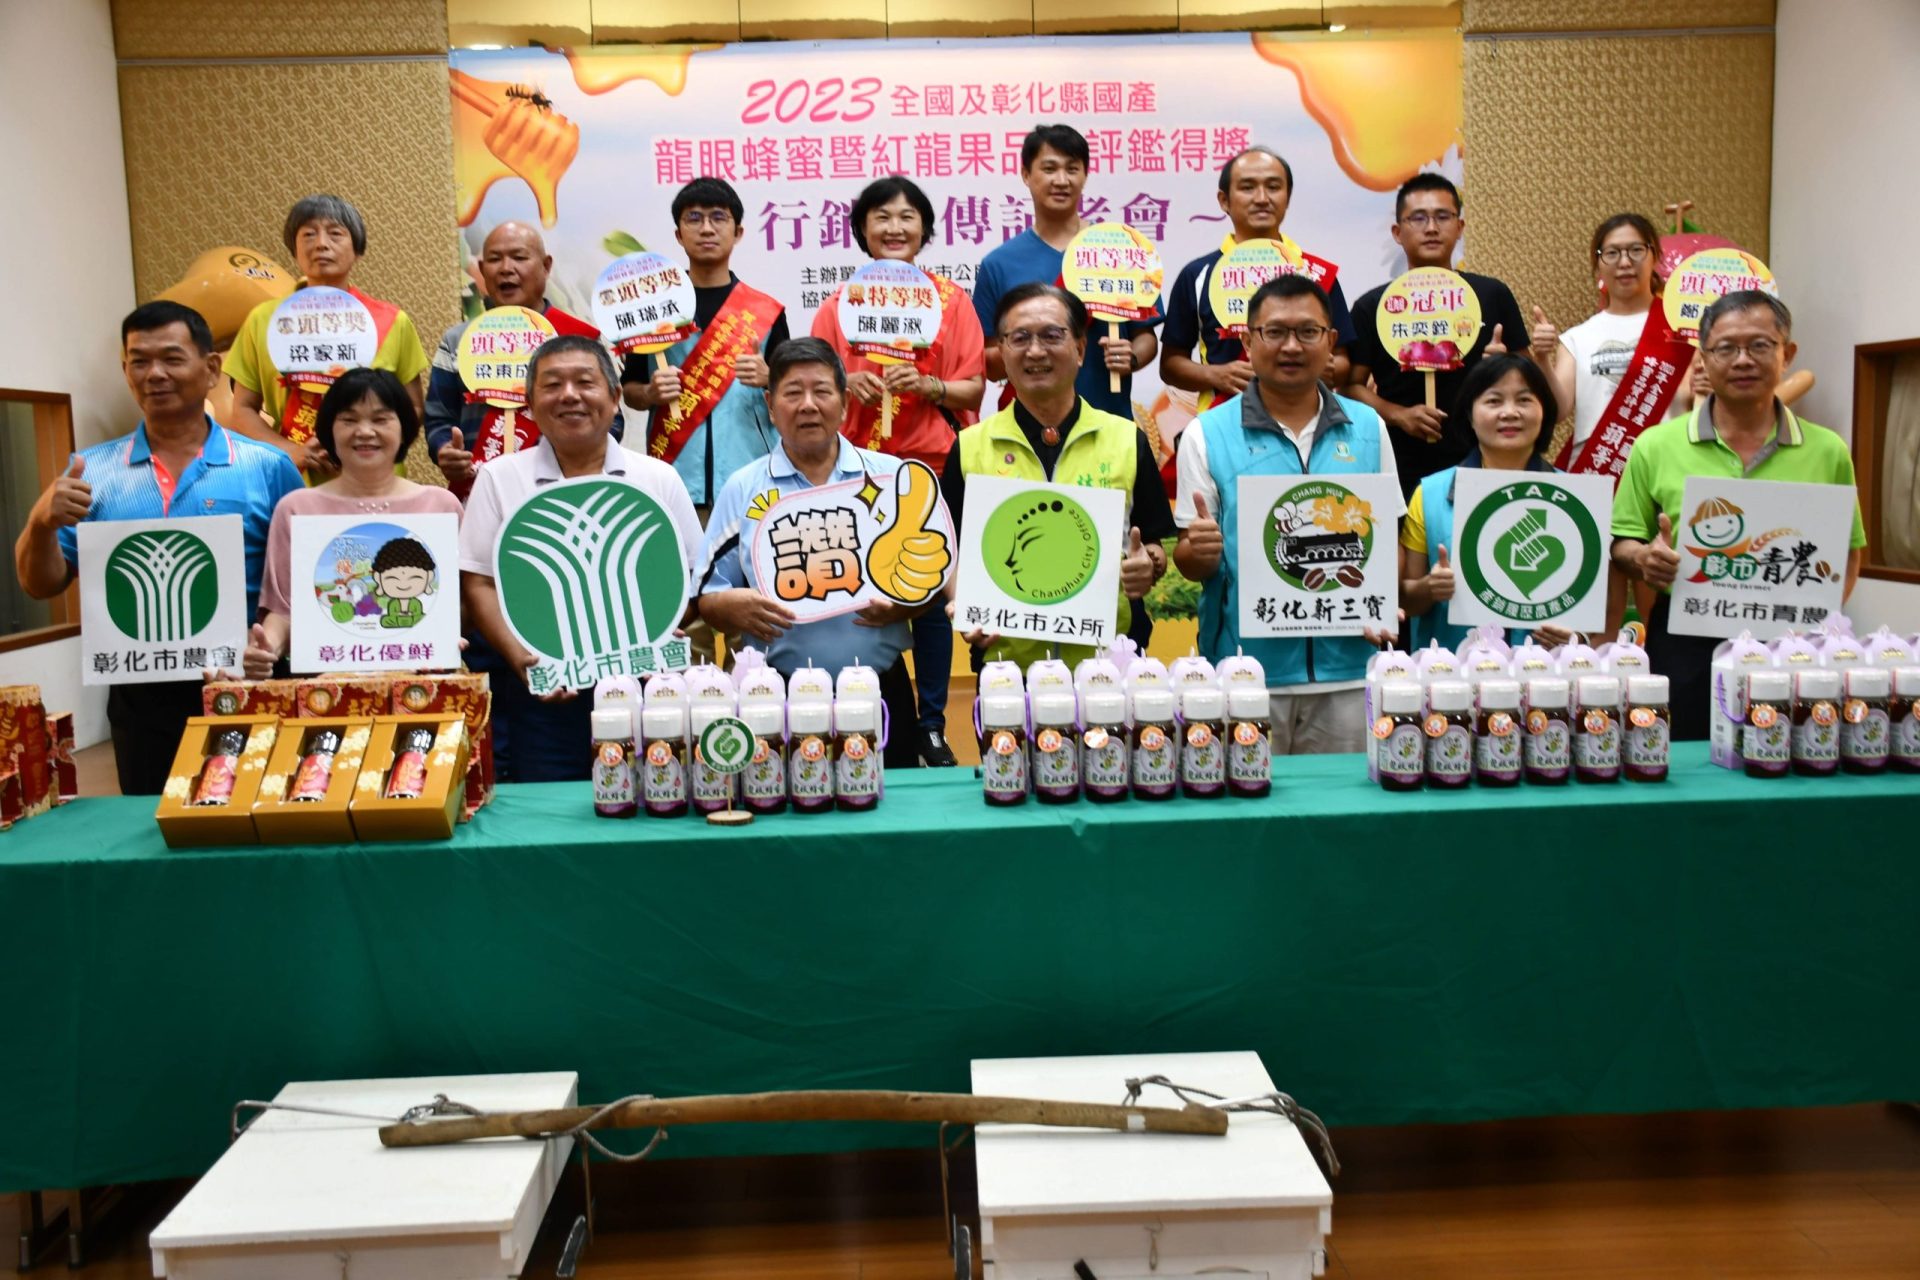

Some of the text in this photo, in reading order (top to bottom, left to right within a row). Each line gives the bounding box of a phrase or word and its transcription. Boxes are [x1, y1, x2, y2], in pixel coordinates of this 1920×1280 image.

[741, 78, 1158, 125] 2023 全國及彰化縣國產
[654, 126, 1252, 186] 龍眼蜂蜜暨紅龍果品評鑑得獎
[1077, 247, 1147, 270] 頭等獎
[618, 268, 682, 303] 頭等獎
[868, 285, 934, 309] 特等獎
[1410, 287, 1465, 313] 冠軍
[297, 312, 367, 335] 頭等獎
[1292, 485, 1344, 502] CHANG HUA
[1501, 484, 1569, 502] TAP
[768, 507, 862, 601] 讚
[1031, 507, 1096, 599] Changhua City Office
[965, 604, 1105, 638] 彰化市公所
[1253, 595, 1387, 624] 彰化新三寶
[1683, 597, 1829, 624] 彰化市青農
[92, 643, 238, 674] 彰化市農會
[318, 642, 435, 663] 彰化優鮮
[530, 646, 690, 694] 彰化市農會
